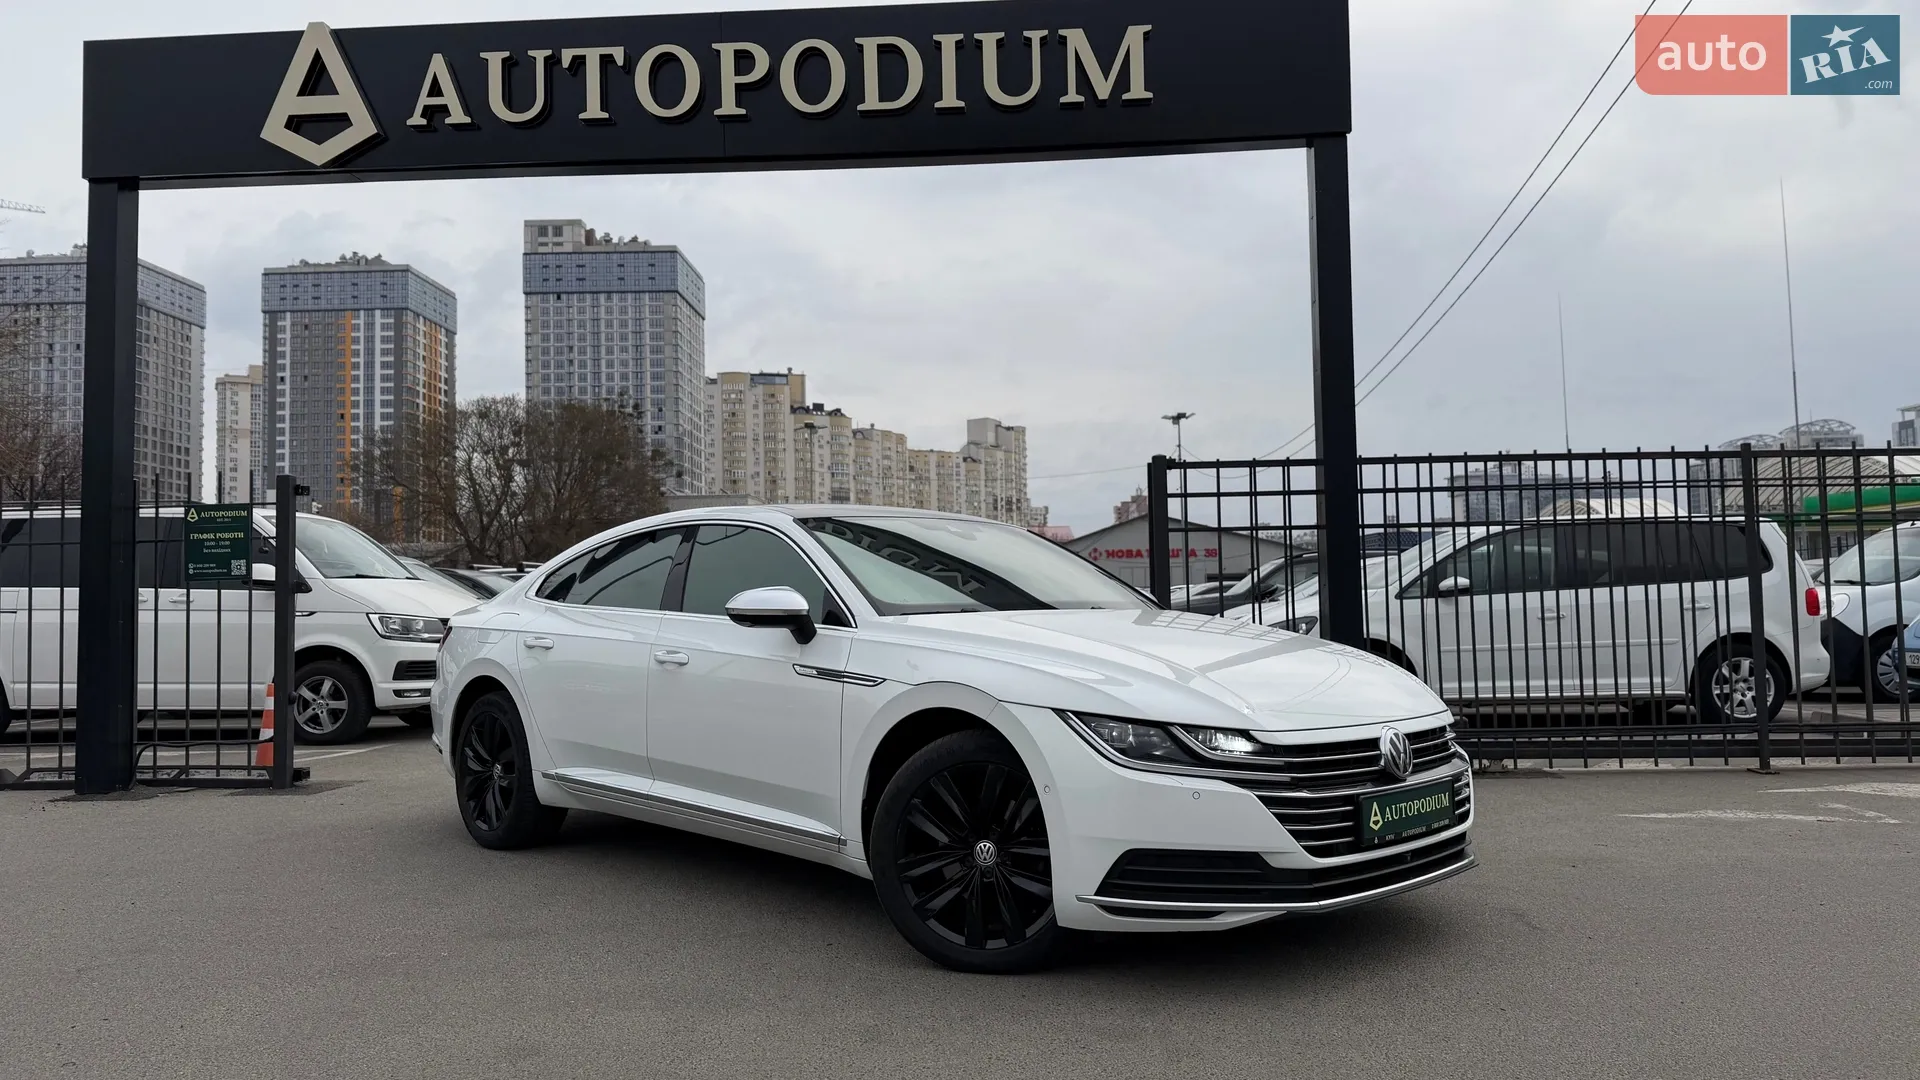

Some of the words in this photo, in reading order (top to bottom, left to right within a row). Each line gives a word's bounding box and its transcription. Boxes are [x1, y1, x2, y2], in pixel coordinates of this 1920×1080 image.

[405, 24, 1154, 127] AUTOPODIUM
[200, 510, 248, 518] AUTOPODIUM
[1105, 548, 1144, 559] НОВА
[1384, 792, 1450, 822] AUTOPODIUM
